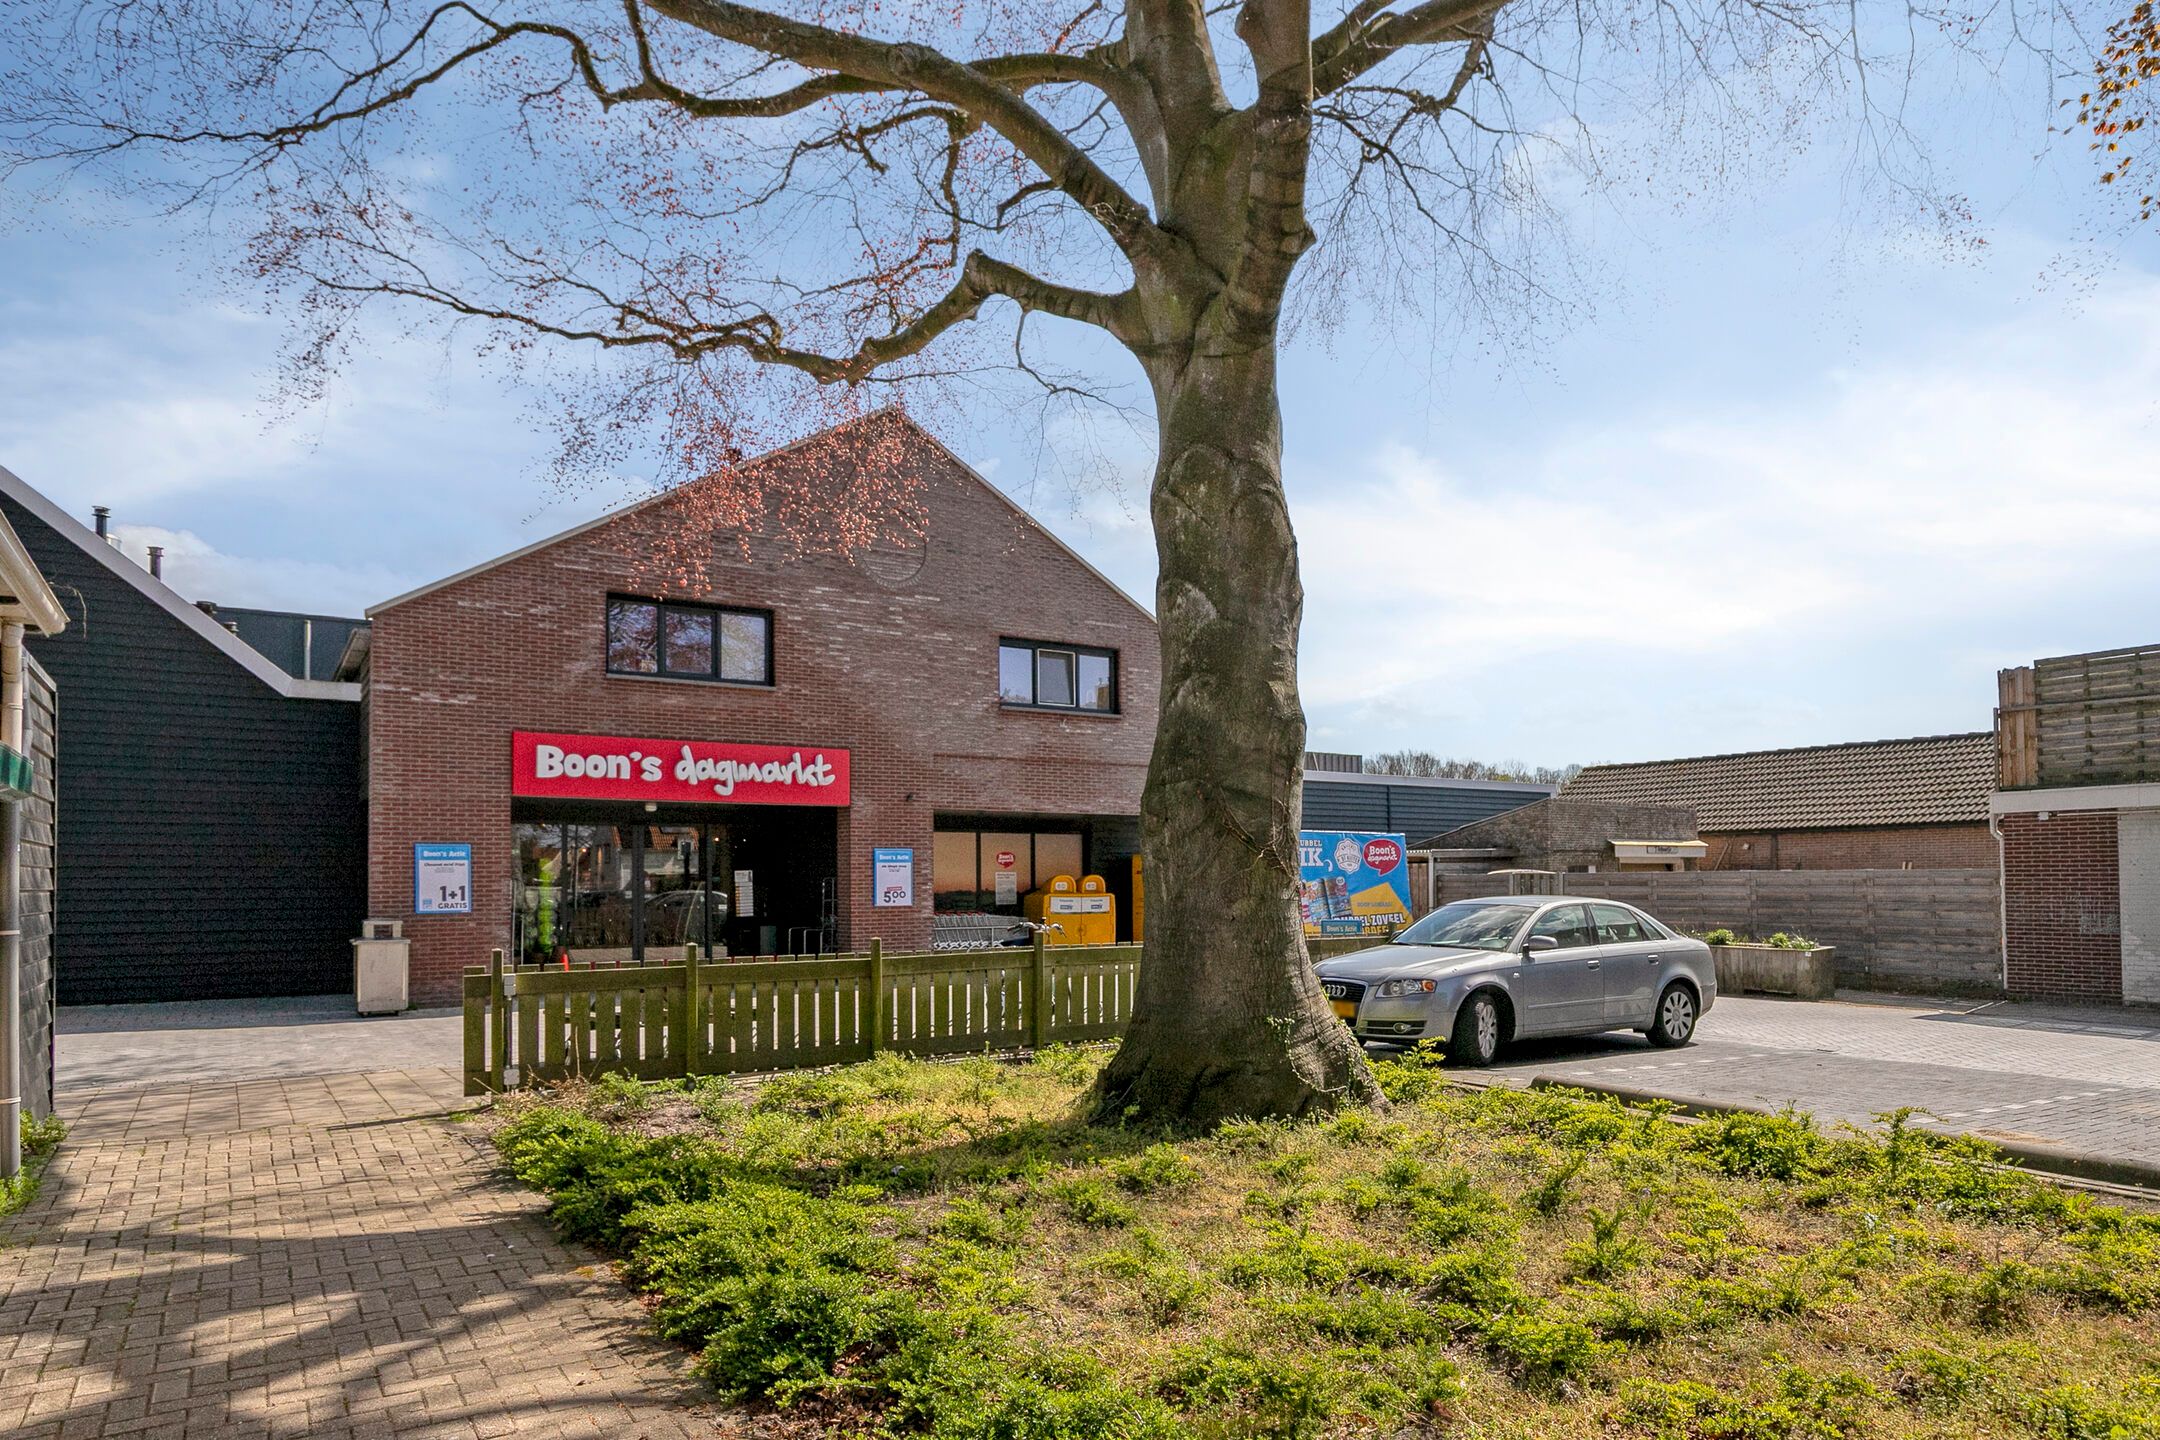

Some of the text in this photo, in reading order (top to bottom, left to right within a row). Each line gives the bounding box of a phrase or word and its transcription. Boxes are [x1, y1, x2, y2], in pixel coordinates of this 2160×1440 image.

[536, 744, 836, 796] Boon's dagmarkt
[1369, 845, 1396, 855] Boon's
[439, 885, 466, 901] 1+1
[1371, 913, 1406, 926] ZOVEEL
